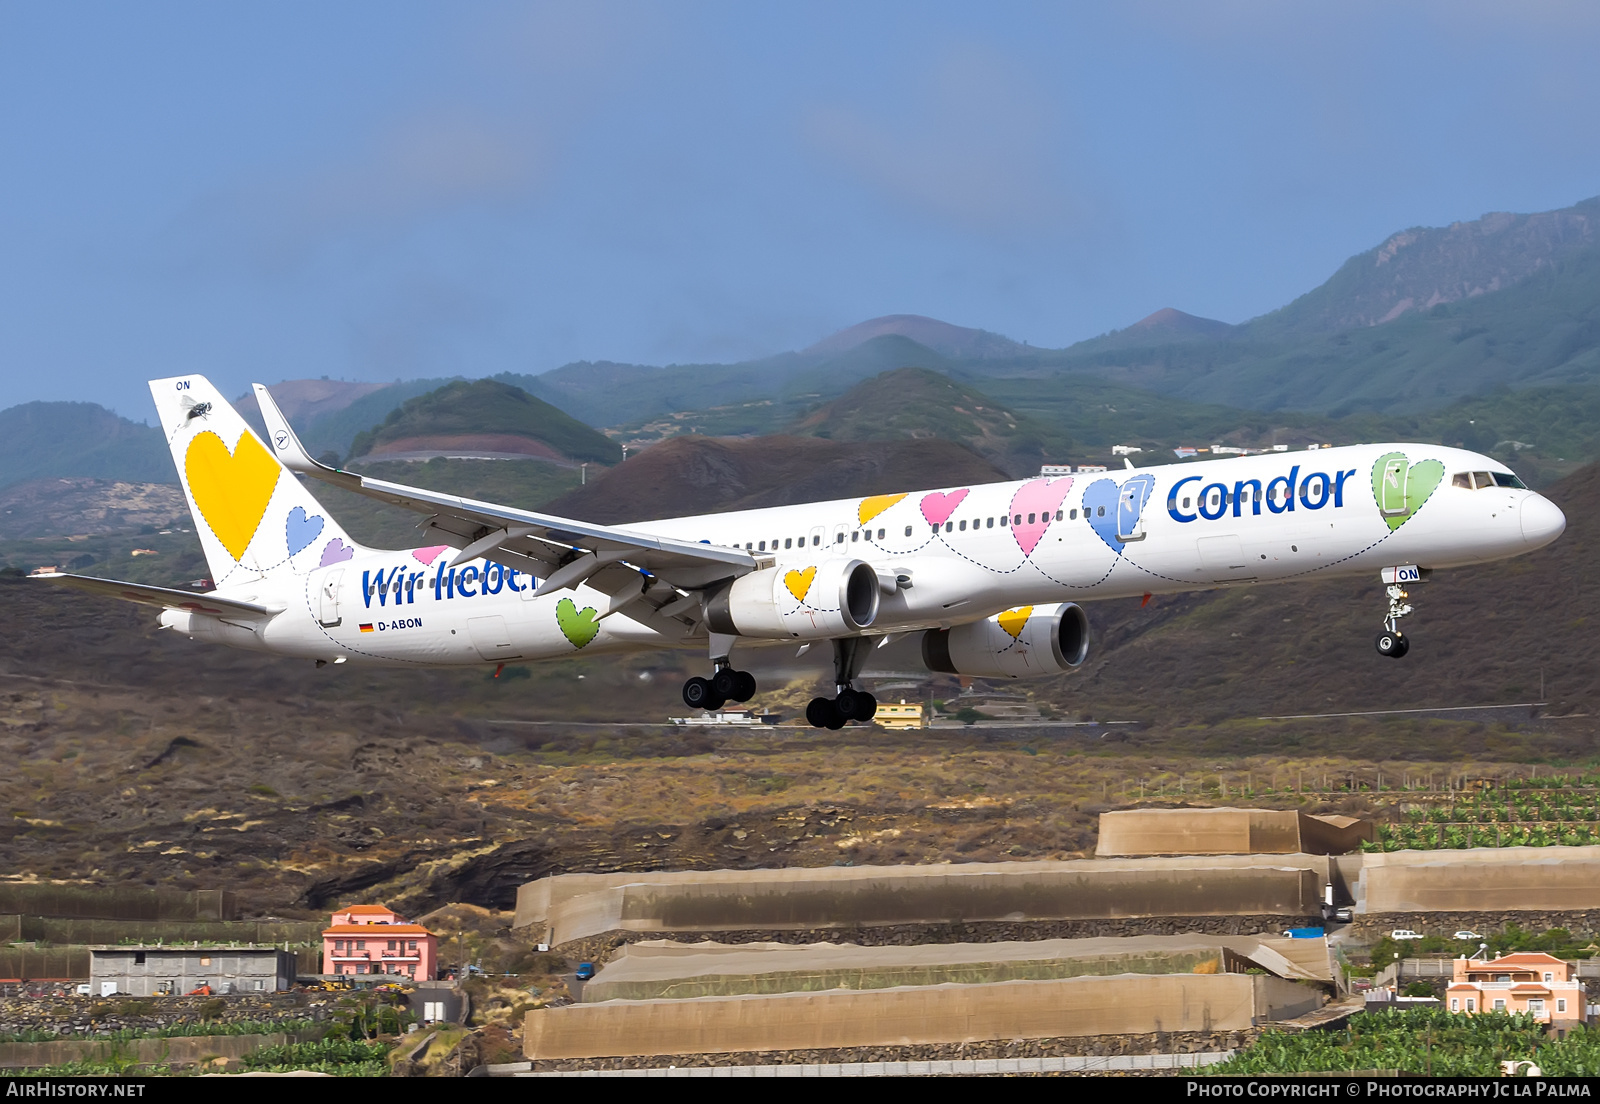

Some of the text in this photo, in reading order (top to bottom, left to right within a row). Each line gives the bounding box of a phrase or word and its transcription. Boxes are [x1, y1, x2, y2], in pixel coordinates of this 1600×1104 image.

[176, 380, 191, 391] ON
[1166, 465, 1357, 524] Condor
[1398, 569, 1419, 580] ON
[362, 565, 425, 609] Wir
[378, 617, 423, 632] D-ABON
